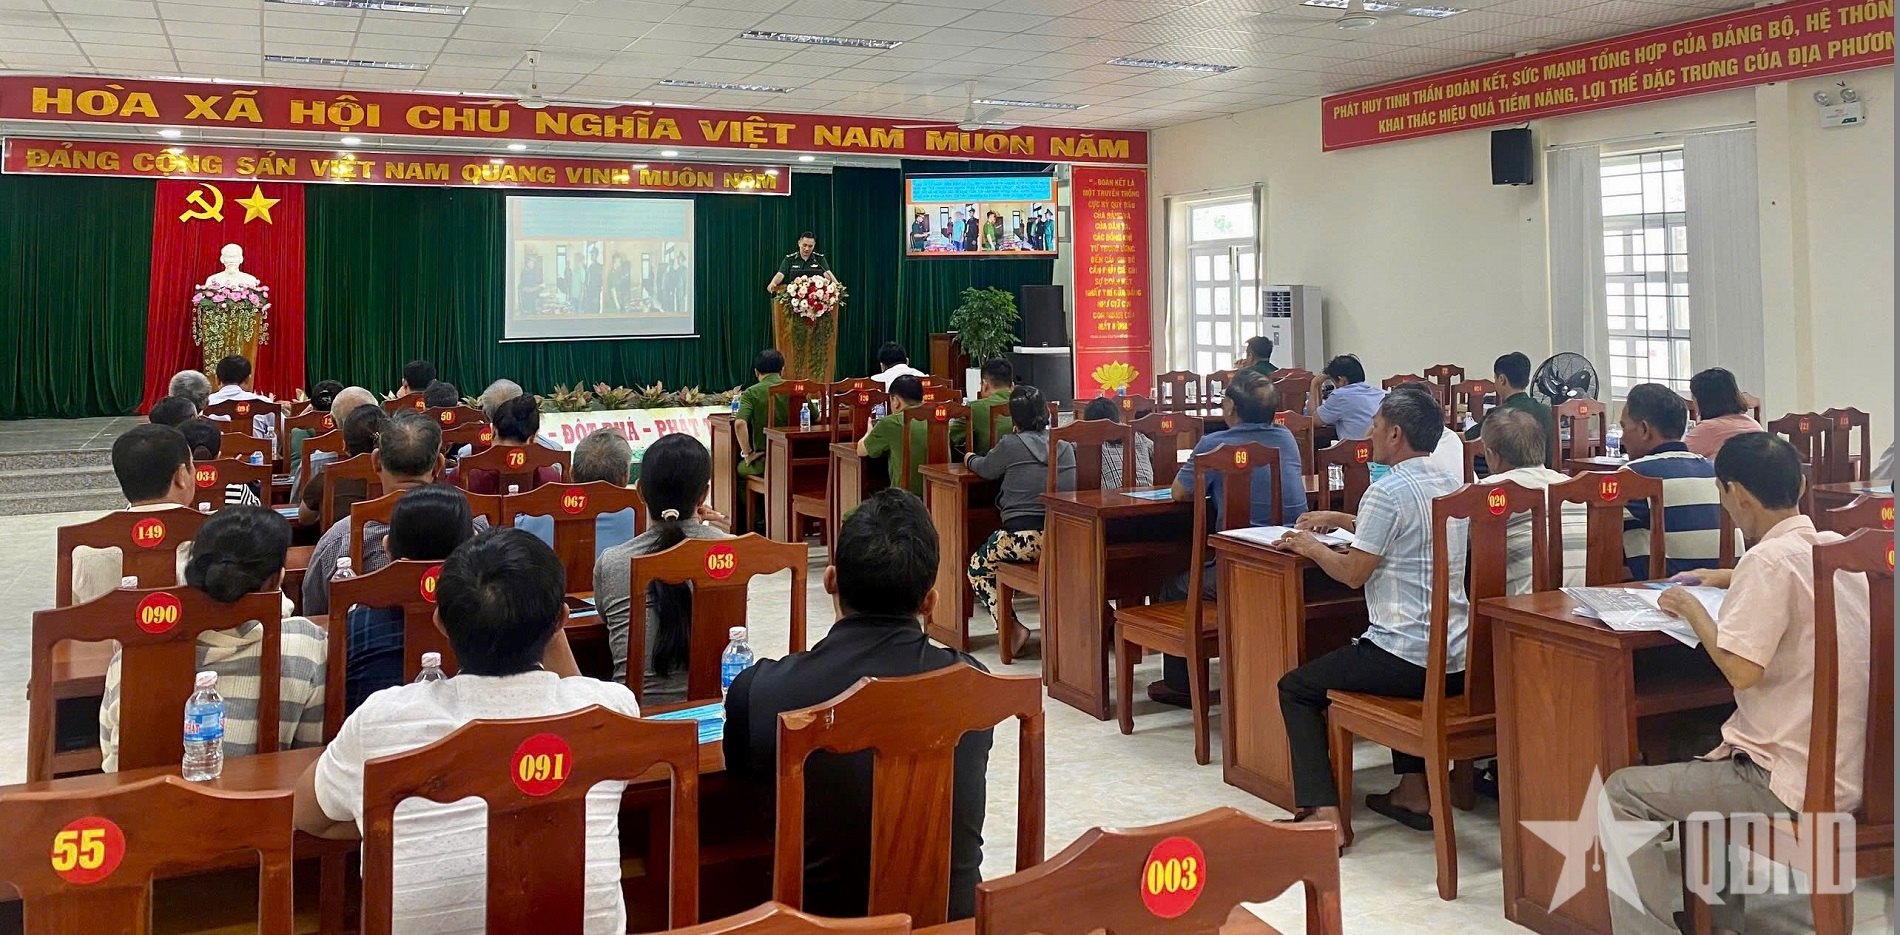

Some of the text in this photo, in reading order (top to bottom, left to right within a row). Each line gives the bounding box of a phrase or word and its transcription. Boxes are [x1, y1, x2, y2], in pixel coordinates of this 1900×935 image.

[1333, 101, 1359, 119] PHÁT
[1362, 98, 1382, 114] HUY
[1385, 93, 1410, 109] TINH
[1446, 78, 1479, 98] ĐOÀN
[1483, 71, 1508, 91] KẾT,
[1513, 67, 1539, 86] SỨC
[1543, 58, 1586, 81] MẠNH
[1590, 48, 1630, 72] TỔNG
[1634, 43, 1667, 64] HỢP
[1672, 32, 1706, 56] CỦA
[1711, 24, 1762, 49] ĐẢNG
[1768, 14, 1800, 40] BỘ,
[1806, 8, 1832, 34] HỆ
[1379, 116, 1404, 133] KHAI
[1407, 110, 1436, 129] THÁC
[1440, 104, 1466, 124] HIỆU
[1470, 97, 1495, 119] QUẢ
[1534, 87, 1578, 107] NĂNG,
[1582, 80, 1605, 101] LỢI
[1610, 70, 1638, 95] THẾ
[1642, 68, 1675, 91] ĐẶC
[1681, 58, 1738, 83] TRƯNG
[1744, 47, 1782, 73] CỦA
[1788, 44, 1821, 67] ĐỊA
[184, 90, 263, 122] XÃ
[290, 94, 380, 132] HỘI
[405, 100, 510, 132] CHỦ
[536, 110, 682, 140] NGHĨA
[698, 116, 795, 148] VIỆT
[814, 124, 905, 149] NAM
[926, 129, 1035, 155] MUÔN
[1050, 134, 1129, 158] NĂM
[26, 142, 777, 189] ĐẢNG CỘNG SẢN VIỆT NAM QUANG VINH MUÔN NĂM
[509, 452, 524, 465] 78
[1235, 452, 1247, 464] 69
[1357, 448, 1368, 458] 122
[196, 471, 216, 482] 034
[1602, 482, 1618, 494] 147
[564, 496, 585, 508] 067
[1490, 495, 1506, 507] 020
[137, 525, 163, 540] 149
[708, 553, 733, 570] 058
[141, 604, 178, 625] 090
[519, 753, 564, 781] 091
[51, 829, 105, 871] 55
[1148, 857, 1197, 895] 003
